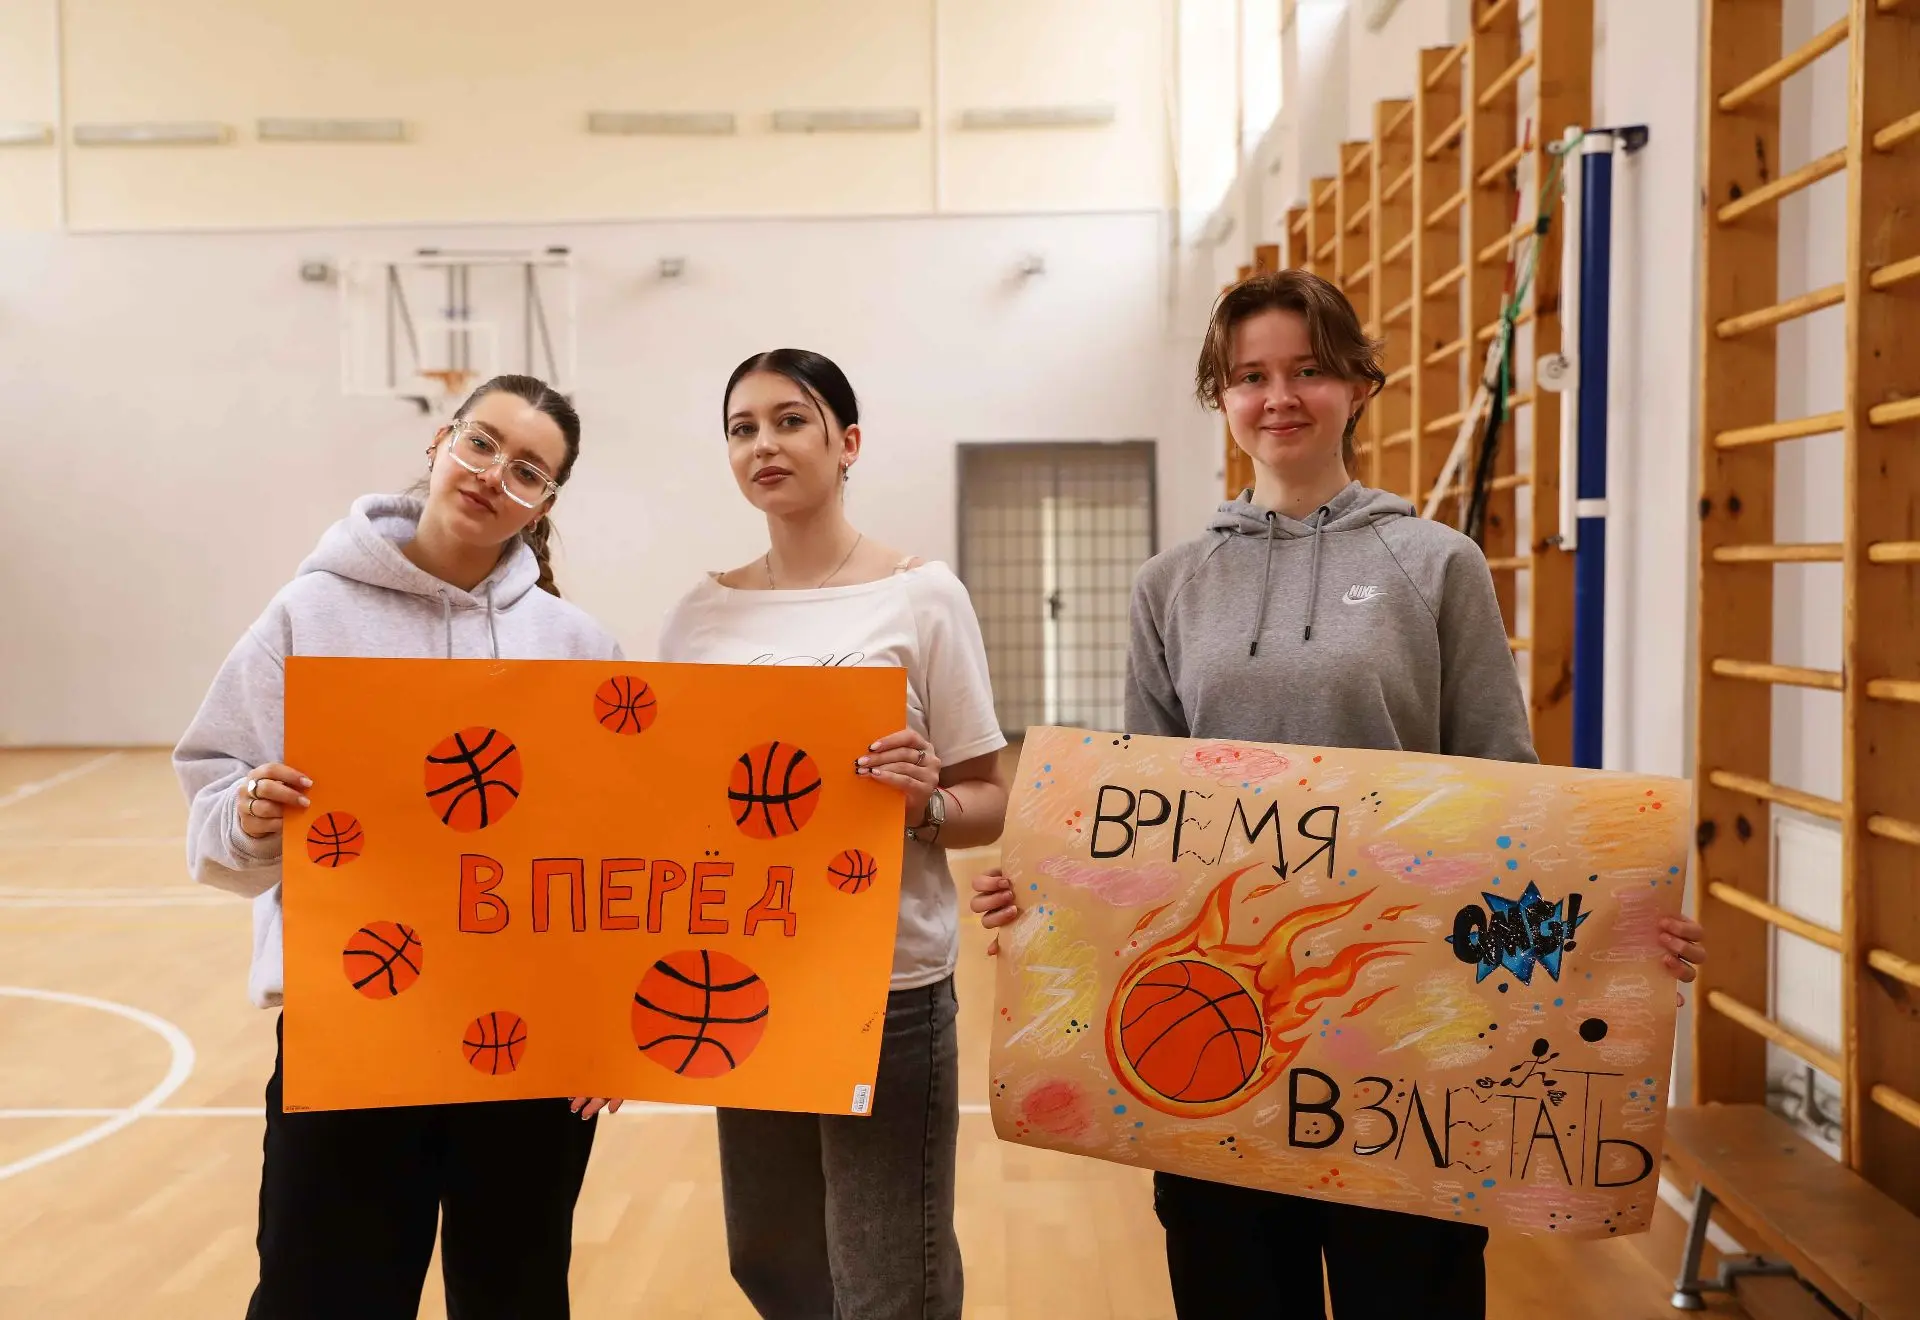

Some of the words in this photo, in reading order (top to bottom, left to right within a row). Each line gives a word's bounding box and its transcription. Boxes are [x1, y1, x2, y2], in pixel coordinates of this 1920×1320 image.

[1349, 584, 1378, 599] NIKE
[1090, 784, 1340, 882] ВРЕМЯ
[458, 849, 797, 937] ВПЕРЁД
[1452, 892, 1583, 967] OMG!
[1288, 1067, 1654, 1188] ВЗЛЕТАТЬ
